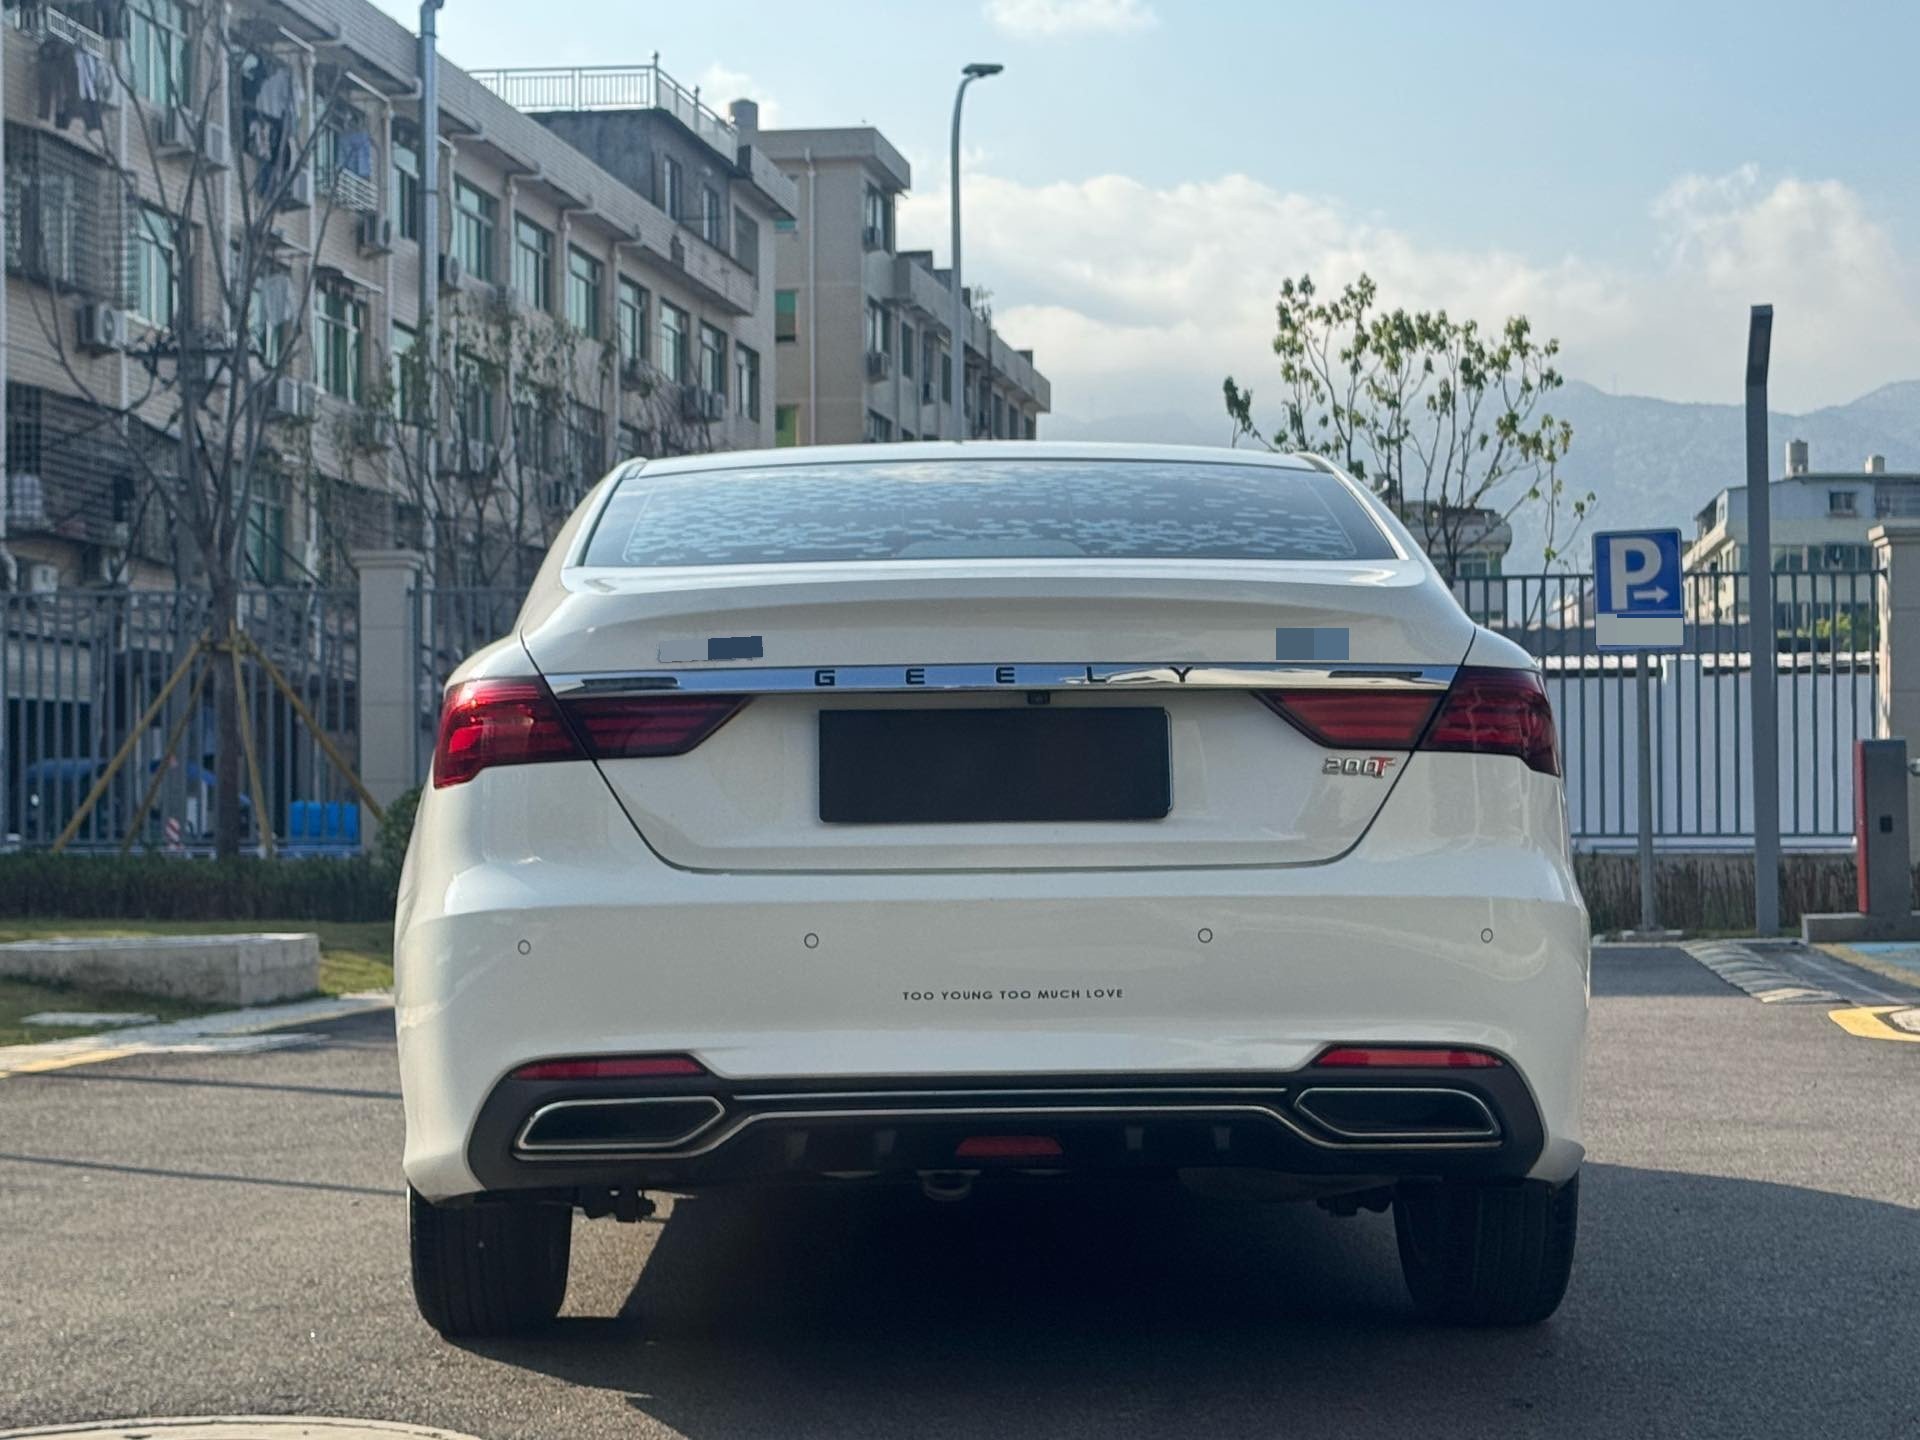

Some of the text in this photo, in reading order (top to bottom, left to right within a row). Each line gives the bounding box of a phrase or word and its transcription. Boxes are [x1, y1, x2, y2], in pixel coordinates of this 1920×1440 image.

[1609, 537, 1662, 610] P
[814, 665, 1193, 687] GEELY
[1321, 756, 1396, 778] 200T
[902, 988, 1123, 1001] TOO YOUNG TOO MUCH LOVE
